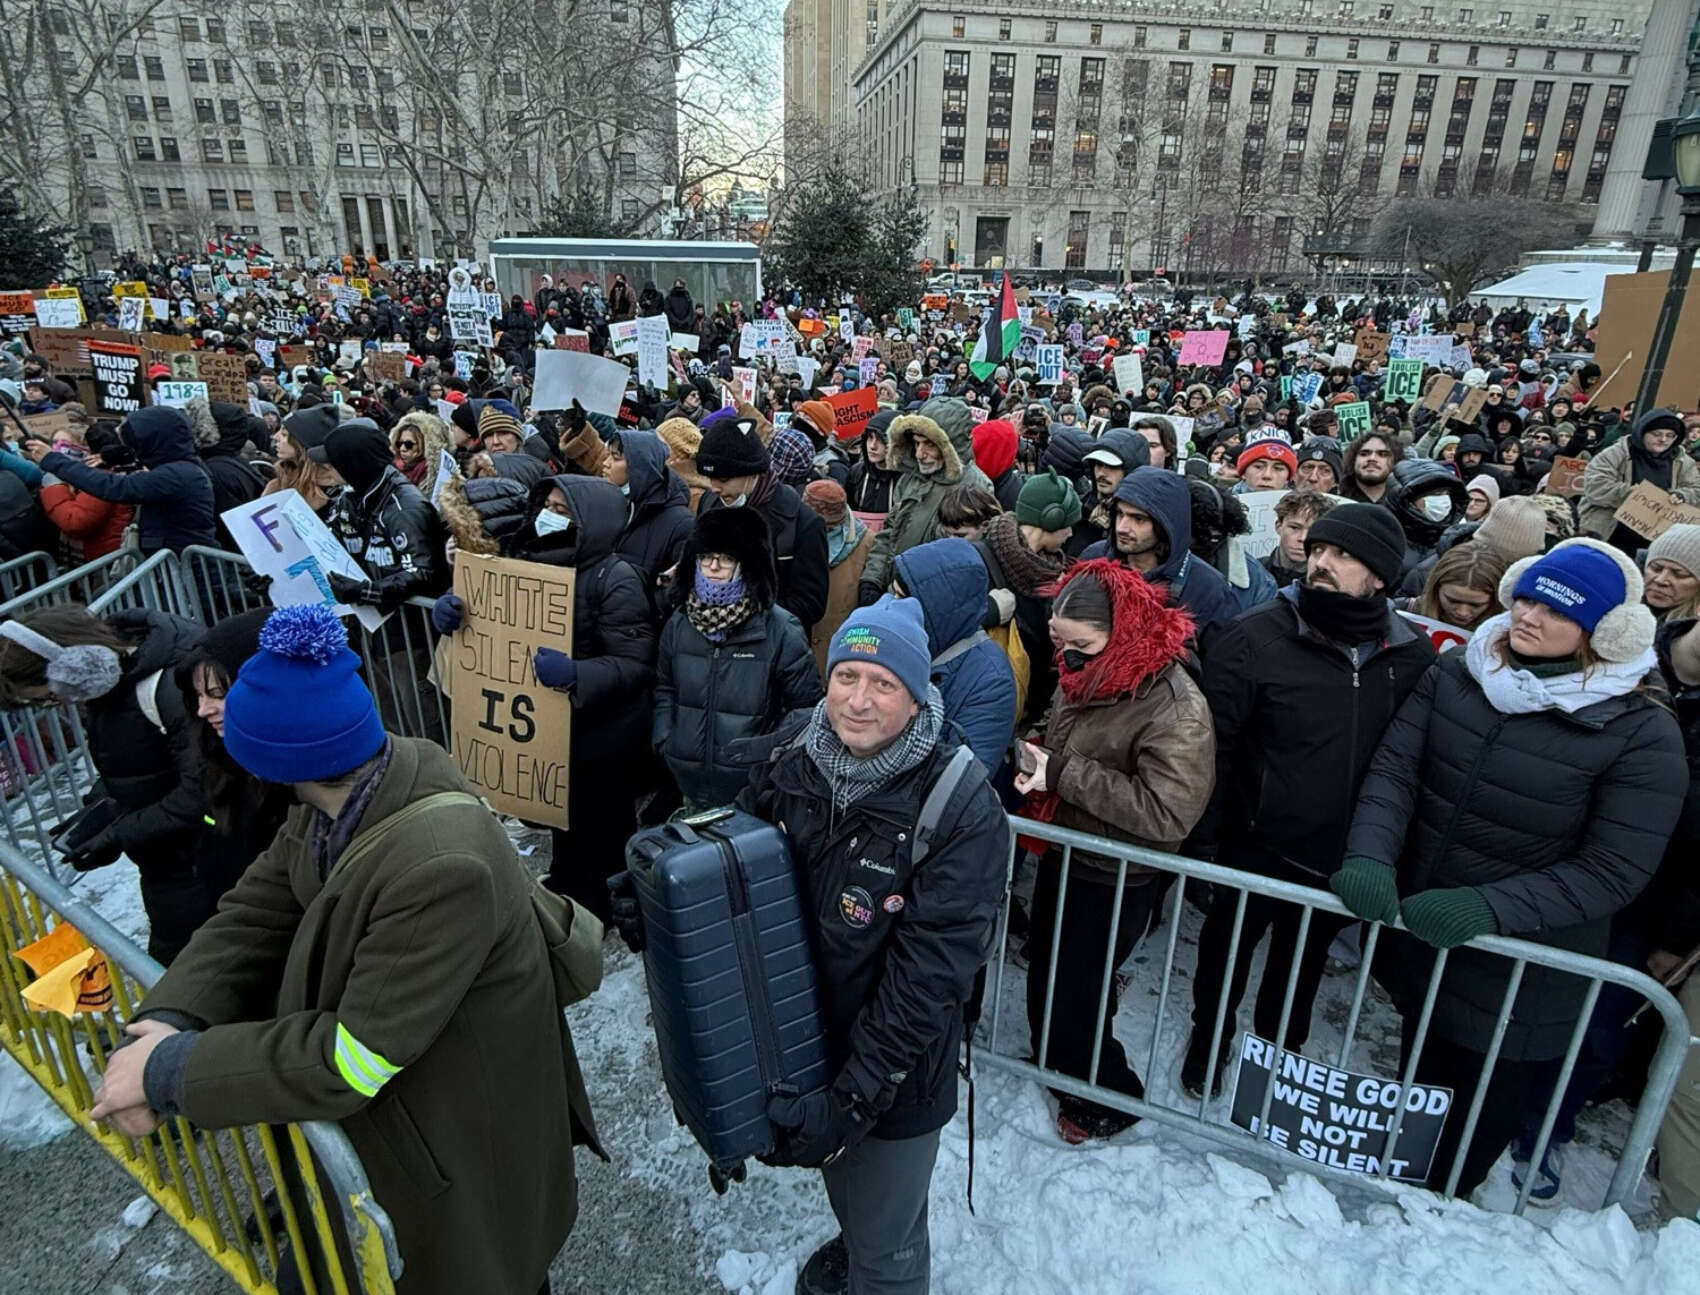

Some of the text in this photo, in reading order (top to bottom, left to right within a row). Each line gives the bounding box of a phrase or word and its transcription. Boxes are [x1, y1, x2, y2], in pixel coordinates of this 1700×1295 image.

[91, 353, 139, 370] TRUMP
[1038, 349, 1061, 364] ICE
[1038, 365, 1061, 380] OUT
[1391, 360, 1420, 371] ABOLISH
[97, 367, 136, 384] MUST
[1389, 371, 1419, 396] ICE
[108, 384, 129, 397] GO
[164, 384, 204, 400] 1984
[104, 396, 139, 412] NOW!
[834, 404, 860, 418] IGHT
[836, 410, 875, 427] ASCISM
[462, 565, 569, 637] WHITE
[478, 687, 536, 743] IS
[456, 731, 567, 809] VIOLENCE
[1273, 1081, 1321, 1115] WE
[1356, 1078, 1450, 1117] GOOD
[1299, 1115, 1368, 1150] NOT
[1297, 1138, 1410, 1177] SILENT
